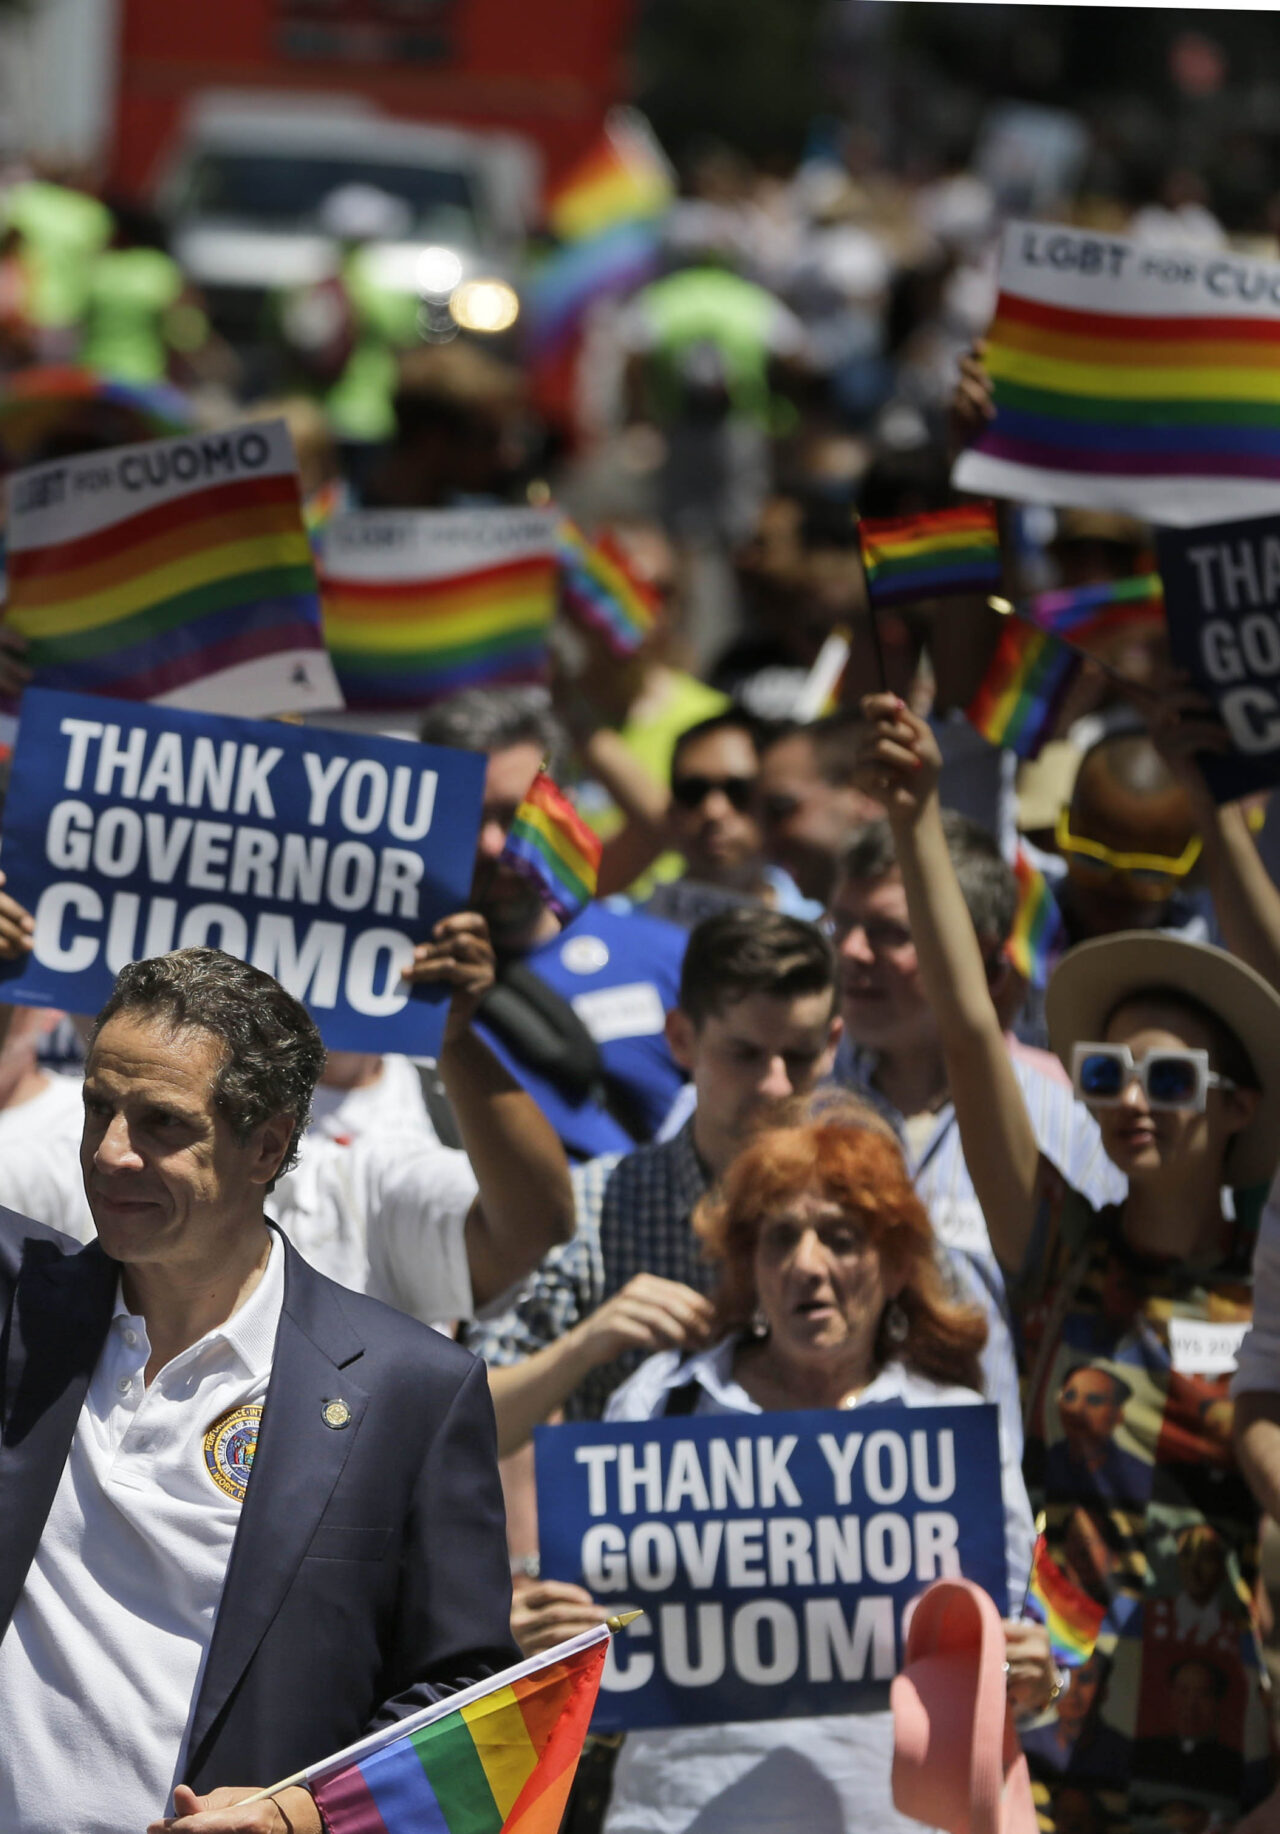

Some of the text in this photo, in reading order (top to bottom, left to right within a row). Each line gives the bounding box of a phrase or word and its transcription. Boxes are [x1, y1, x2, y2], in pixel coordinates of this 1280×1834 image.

[1023, 232, 1129, 278] LGBT
[117, 433, 271, 491] CUOMO
[60, 717, 438, 841] THANK YOU
[45, 799, 425, 919] GOVERNOR
[33, 881, 417, 1017] CUOMO
[213, 1471, 236, 1495] WORK
[575, 1428, 957, 1517] THANK YOU
[581, 1511, 962, 1593] GOVERNOR
[599, 1596, 920, 1692] CUOM
